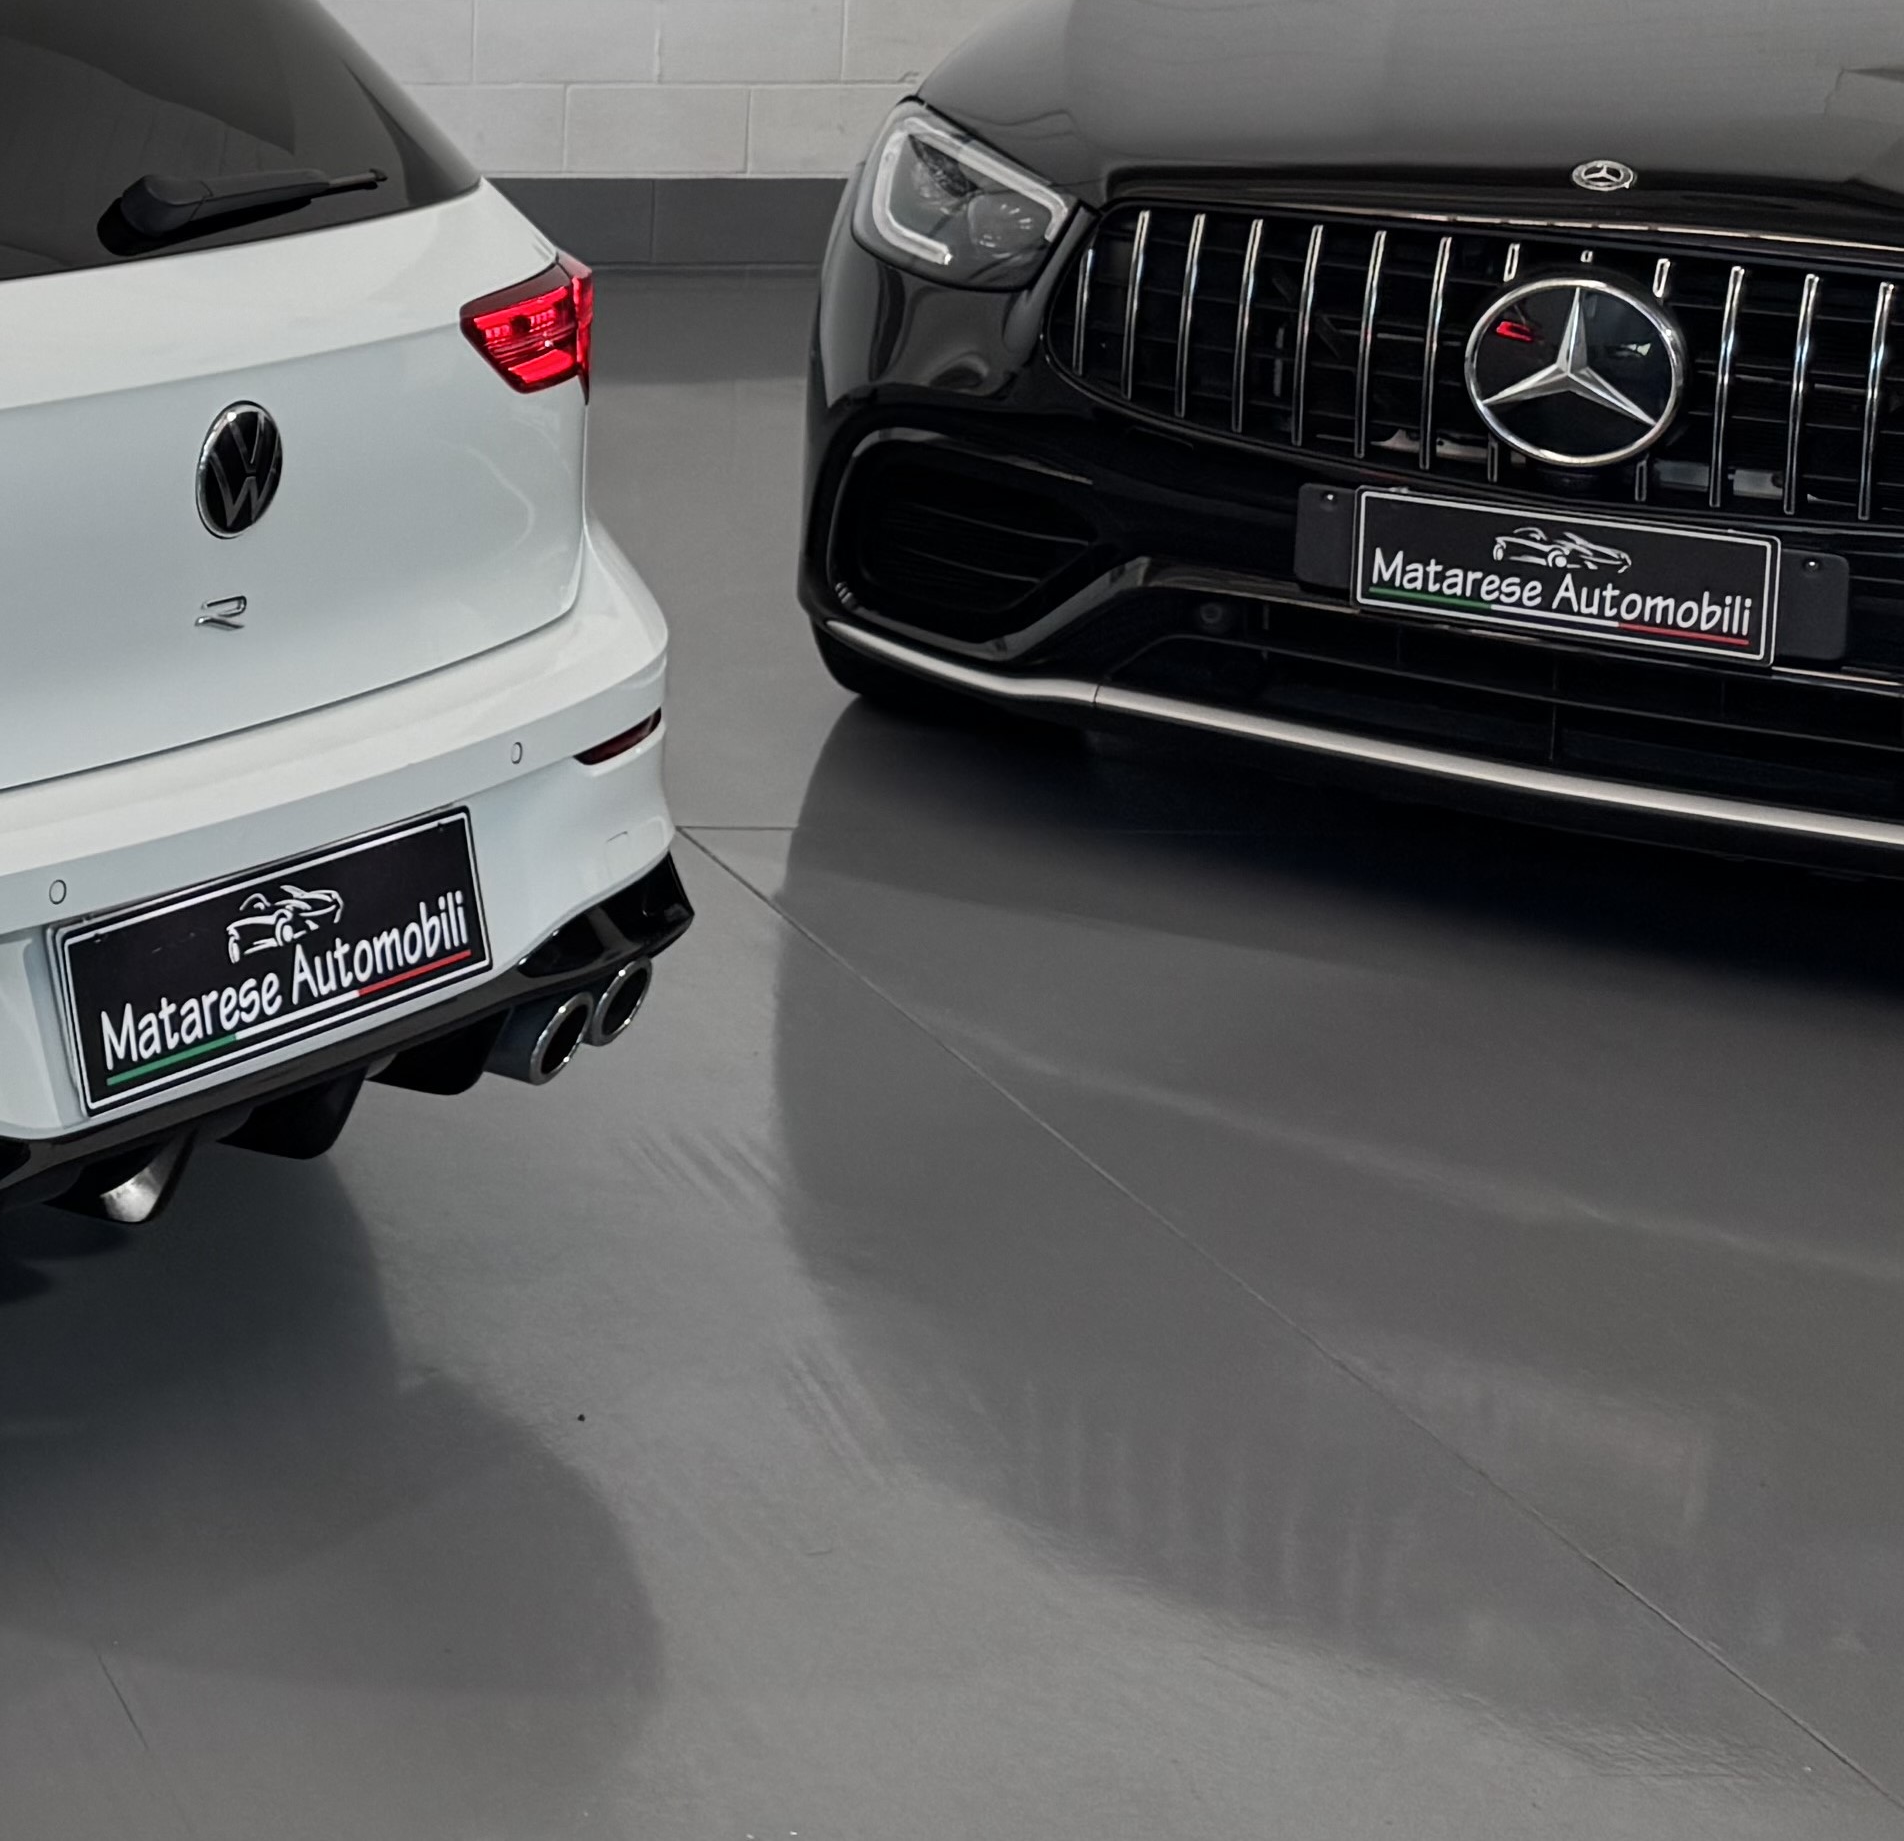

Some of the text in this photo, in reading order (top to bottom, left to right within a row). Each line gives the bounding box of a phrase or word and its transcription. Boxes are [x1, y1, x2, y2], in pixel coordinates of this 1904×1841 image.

[1371, 546, 1753, 637] Matarese Automobili
[99, 889, 469, 1072] Matarese Automobili
